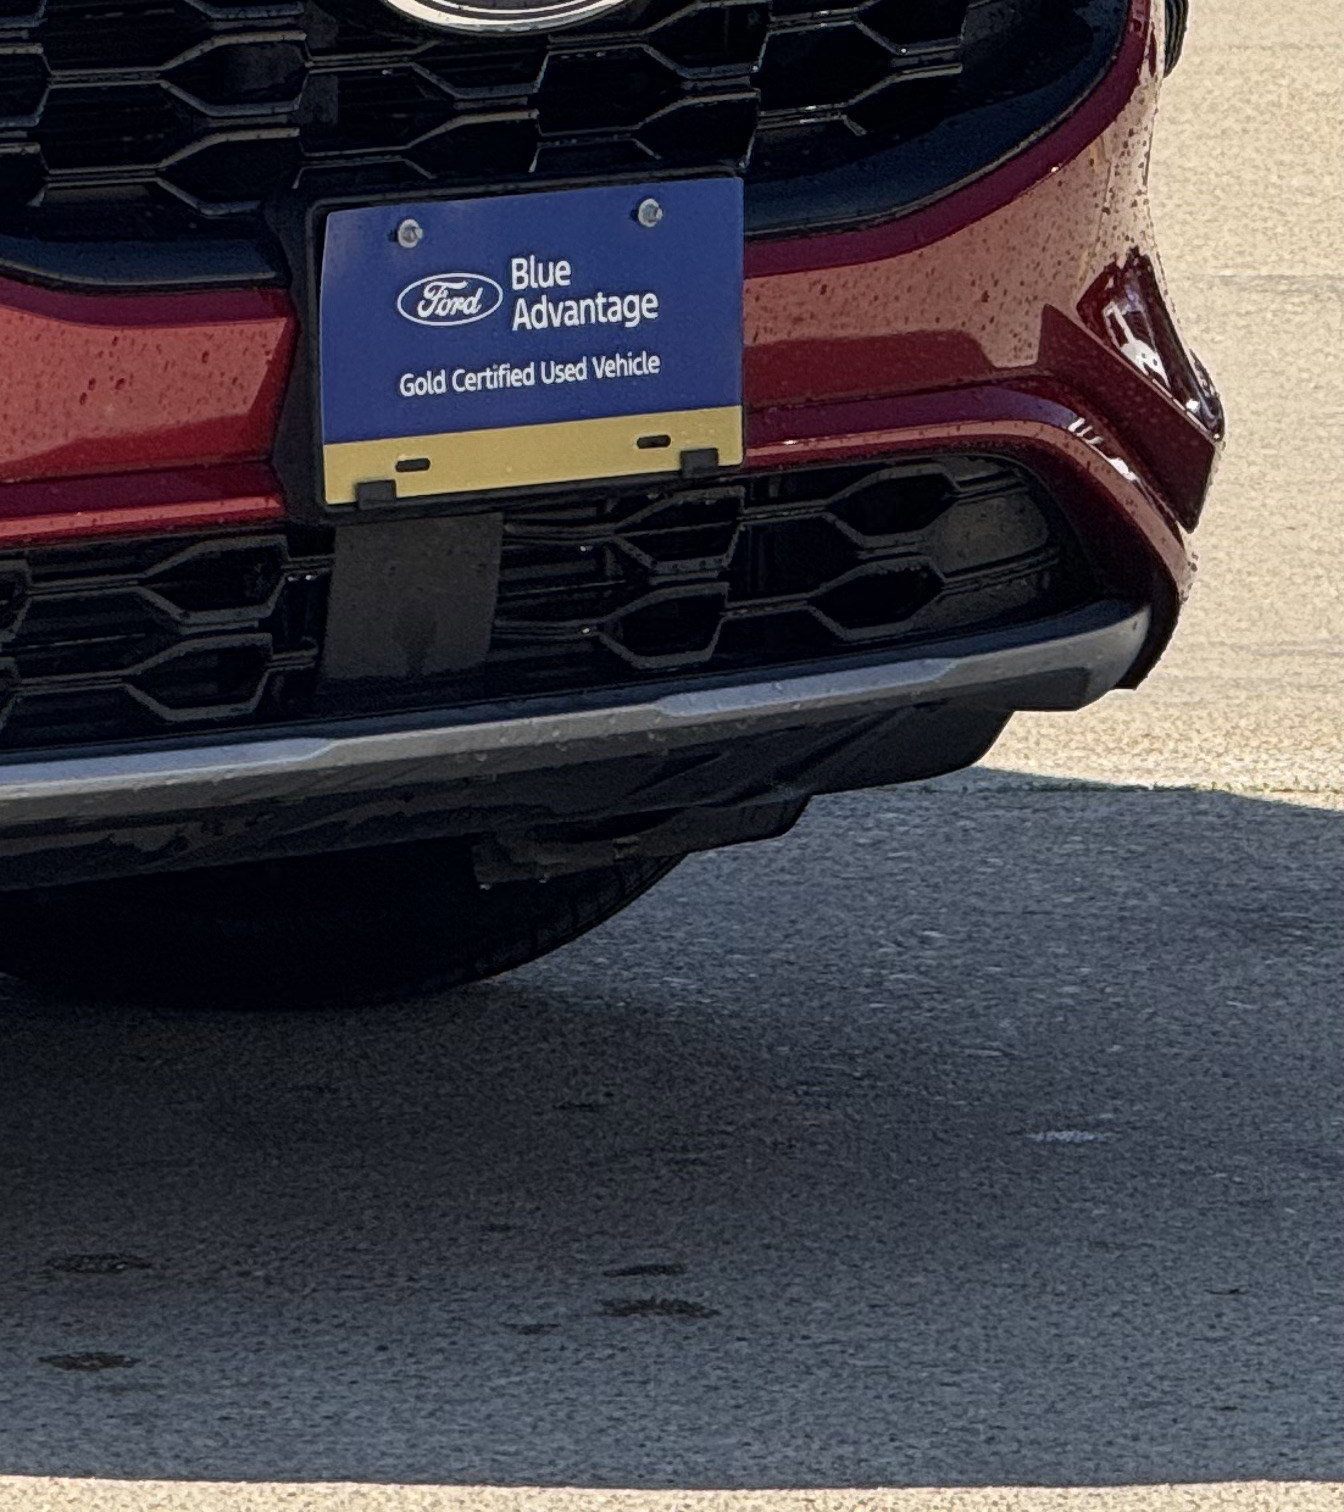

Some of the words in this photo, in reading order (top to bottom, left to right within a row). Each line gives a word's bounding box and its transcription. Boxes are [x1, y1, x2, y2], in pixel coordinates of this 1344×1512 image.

[512, 254, 572, 291] Blue
[416, 280, 485, 320] Ford
[512, 291, 660, 332] Advantage
[399, 368, 447, 398] Gold
[452, 362, 536, 393] Certified
[540, 355, 589, 386] Used
[592, 349, 662, 380] Vehicle
